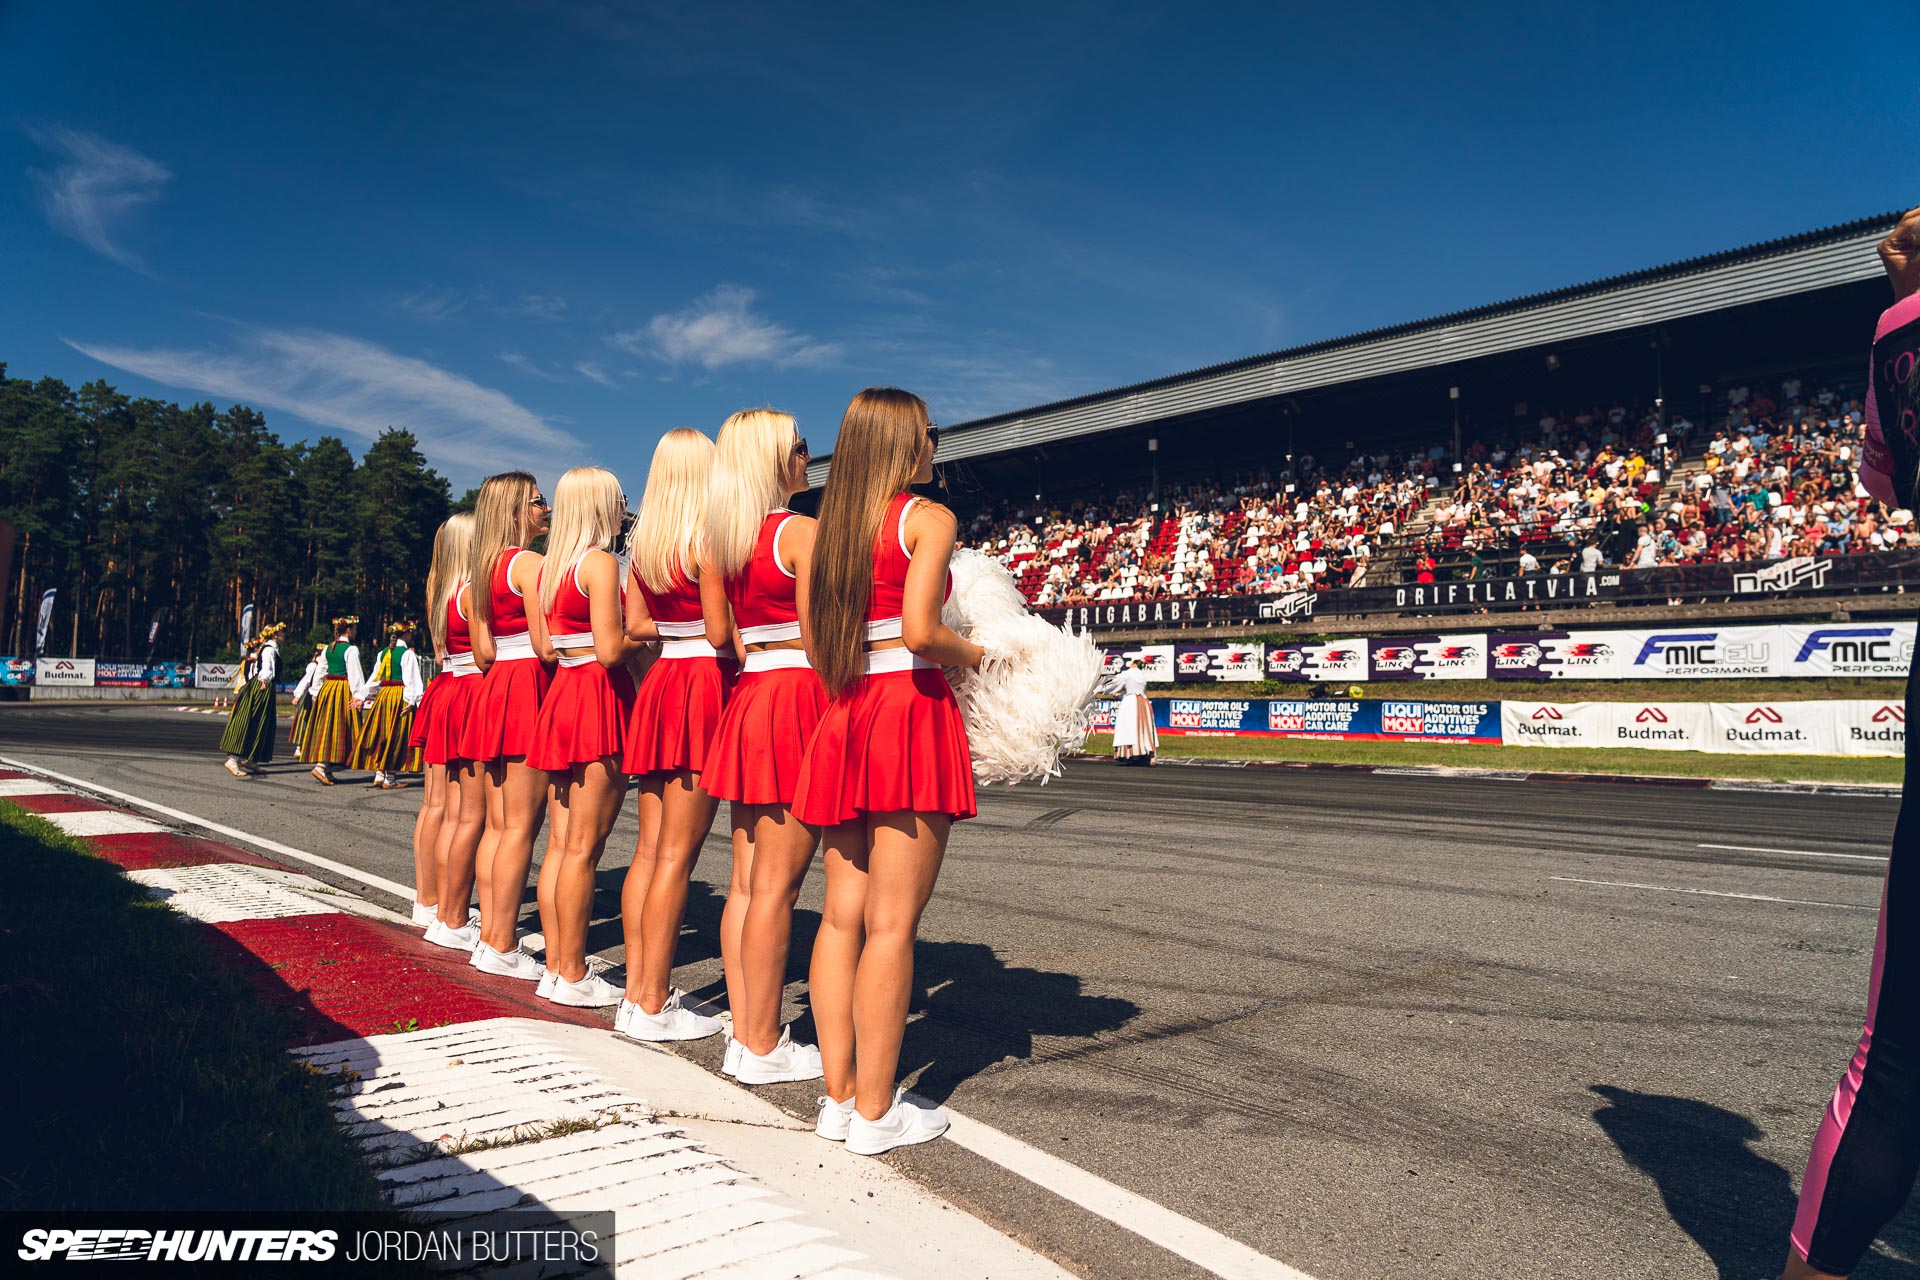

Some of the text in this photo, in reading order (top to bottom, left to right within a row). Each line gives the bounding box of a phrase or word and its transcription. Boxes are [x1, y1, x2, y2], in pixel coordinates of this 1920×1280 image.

[1733, 558, 1833, 593] DRIFT
[1259, 591, 1318, 618] DRIFT
[1066, 600, 1198, 625] #RIGABABY
[1794, 628, 1914, 663] FMIC.E
[44, 671, 87, 679] Budmat.
[1666, 666, 1769, 674] PERFORMANCE
[1833, 665, 1908, 673] PERFORM
[1172, 702, 1200, 714] LIQUI
[1202, 702, 1250, 712] MOTOR OILS
[1271, 703, 1303, 715] LIQUI
[1305, 702, 1359, 712] MOTOR OILS
[1384, 704, 1422, 718] LIQUI
[1424, 704, 1488, 715] MOTOR OILS
[1171, 714, 1200, 726] MOLY
[1201, 711, 1243, 720] ADDITIVES
[1305, 712, 1352, 721] ADDITIVES
[1424, 714, 1480, 725] ADDITIVES
[1201, 719, 1241, 729] CAR CARE
[1270, 716, 1304, 729] MOLY
[1305, 721, 1349, 731] CAR CARE
[1384, 718, 1423, 732] MOLY
[1424, 724, 1476, 735] CAR CARE
[1518, 723, 1582, 737] Budmat.
[1617, 726, 1690, 740] Budmat.
[1726, 727, 1807, 741] Budmat.
[1851, 727, 1906, 742] Budm
